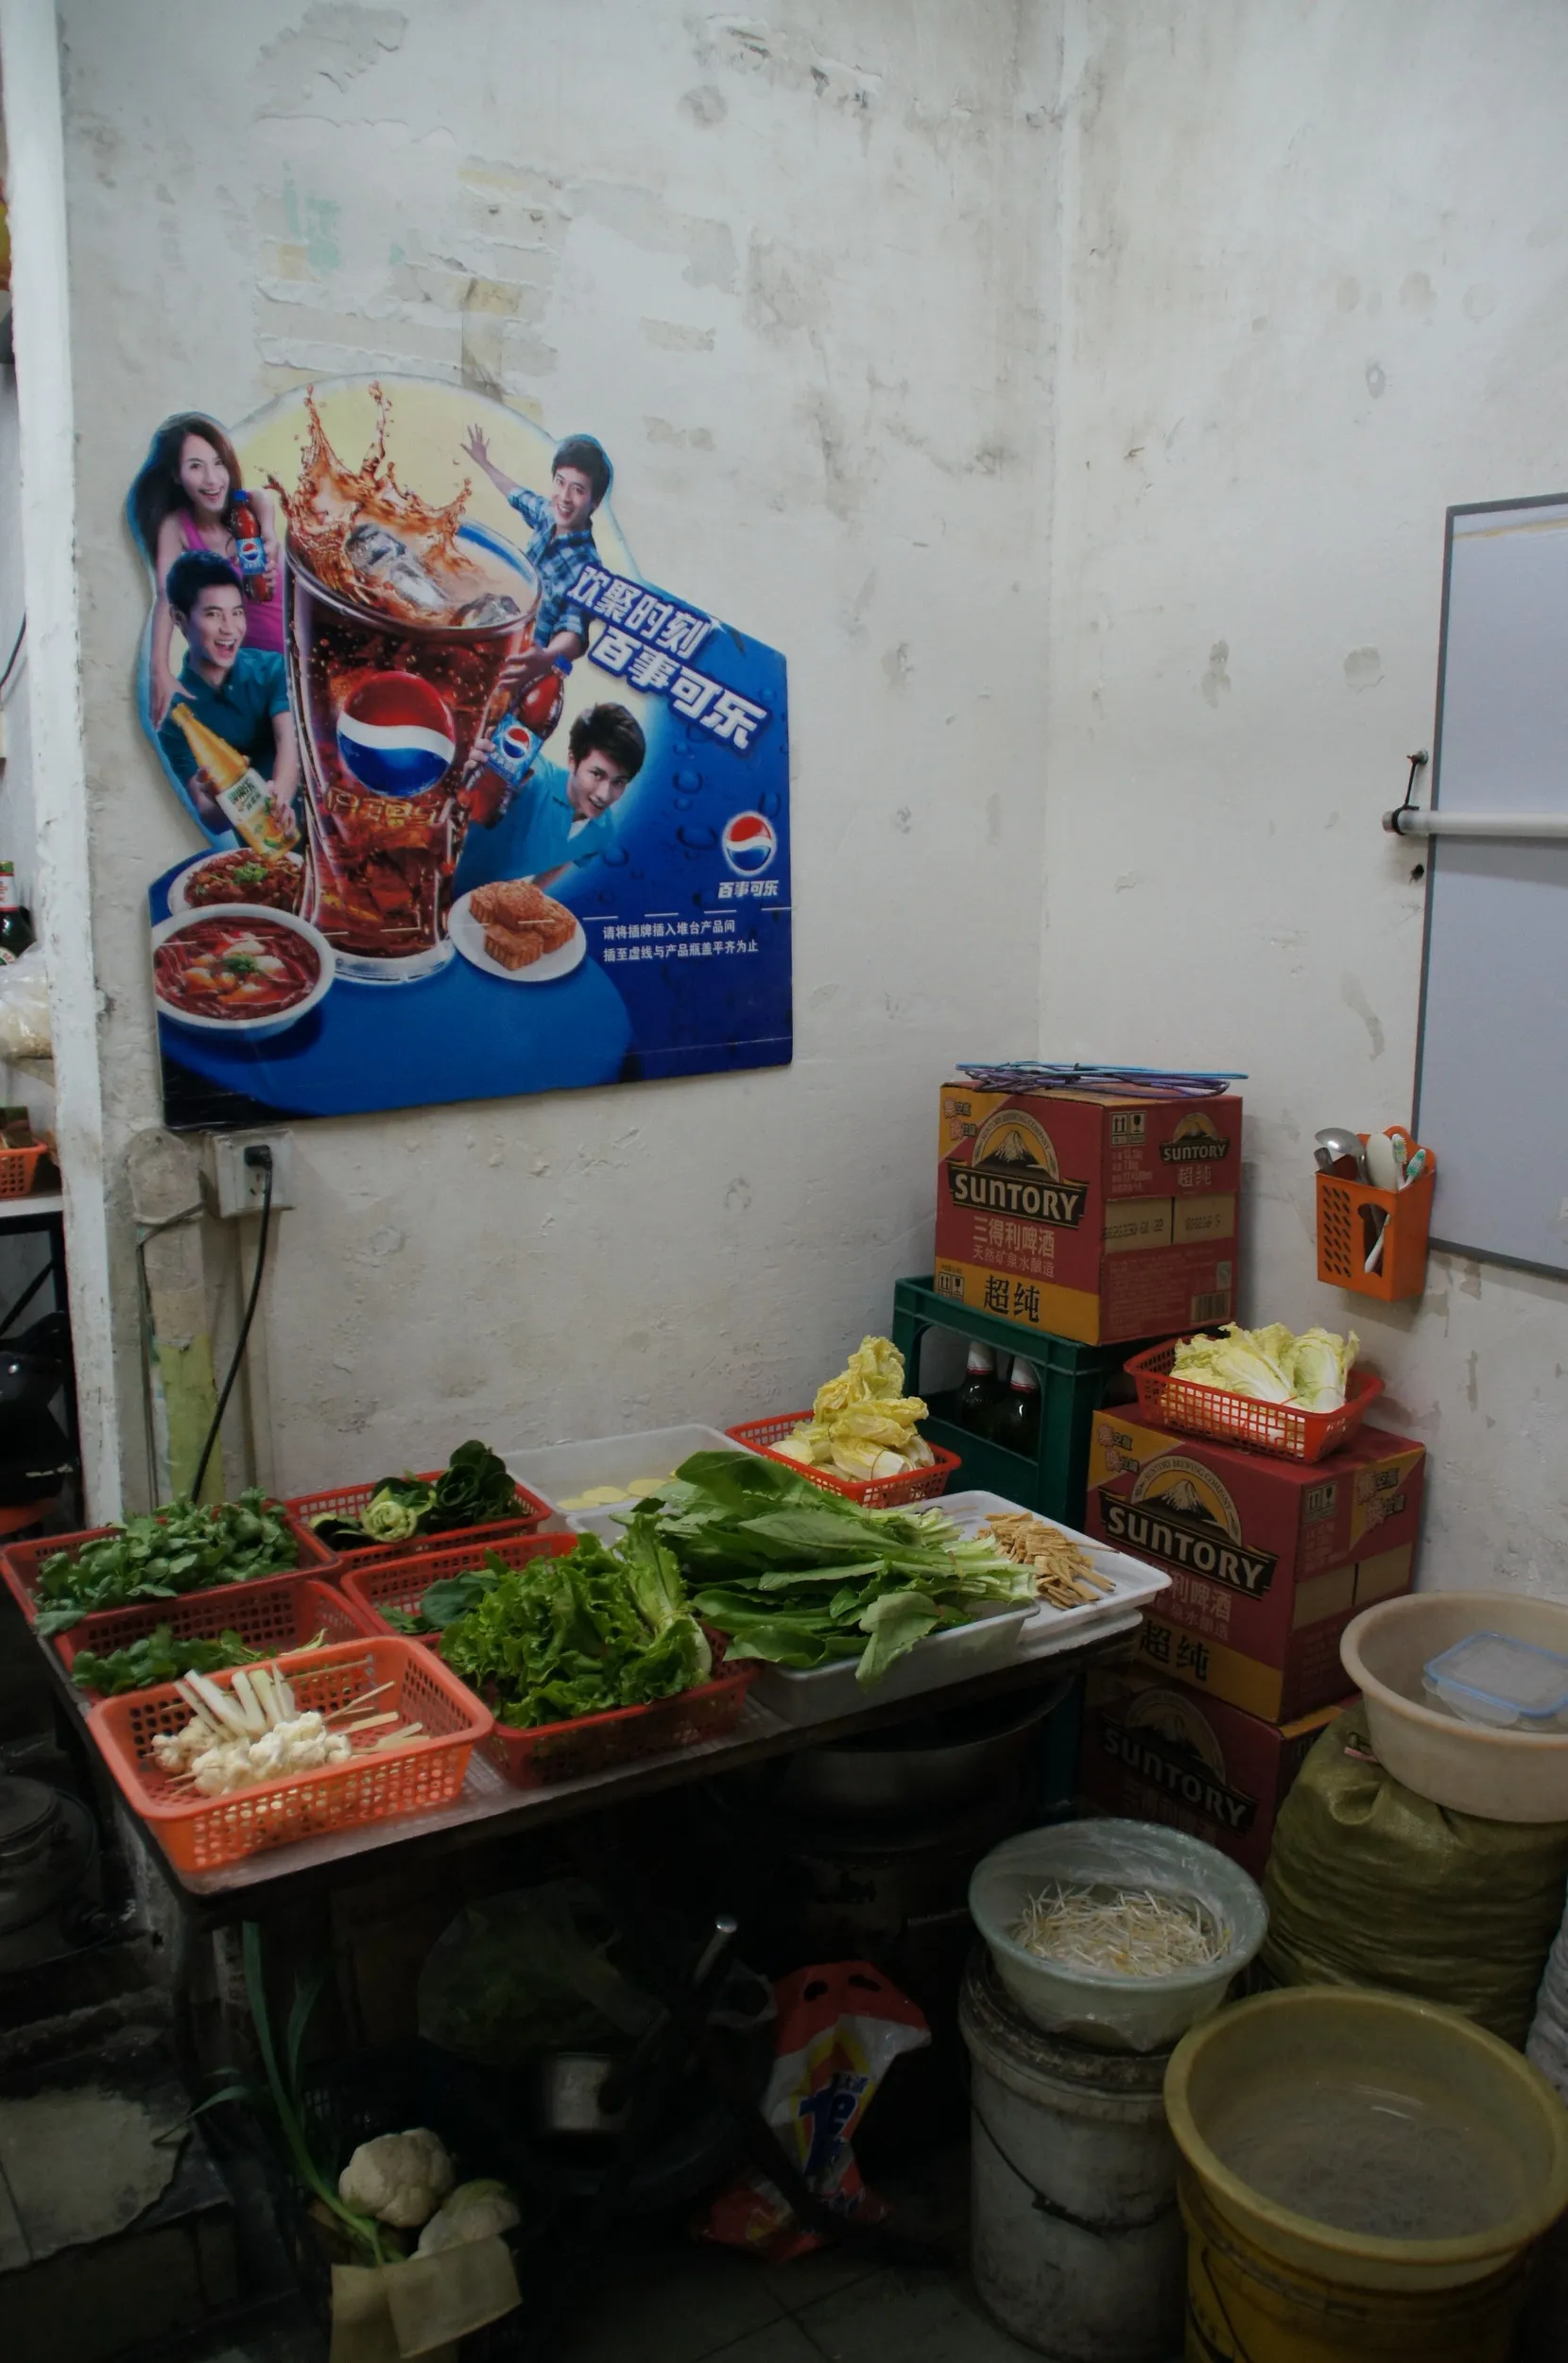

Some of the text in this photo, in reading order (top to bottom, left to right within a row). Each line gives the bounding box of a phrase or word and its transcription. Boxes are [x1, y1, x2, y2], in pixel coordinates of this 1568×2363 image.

[566, 564, 711, 661] 欢聚时刻
[591, 624, 767, 750] 百事可乐
[717, 879, 780, 899] 百事可乐
[602, 919, 736, 940] 请将插牌插入堆台产品间
[603, 939, 759, 963] 插至虚线与产品瓶盖平齐为止
[1163, 1144, 1228, 1162] SUNTORY
[1178, 1164, 1213, 1187] 超纯
[953, 1172, 1079, 1221] SUNTORY
[973, 1216, 1056, 1260] 三得利啤酒
[973, 1245, 1055, 1278] 天然矿泉水酿造
[984, 1274, 1041, 1323] 超纯
[1107, 1506, 1265, 1592] SUNTORY
[1152, 1562, 1232, 1623] 利啤酒
[1139, 1619, 1210, 1682] 超纯
[1104, 1728, 1248, 1827] SUNTORY
